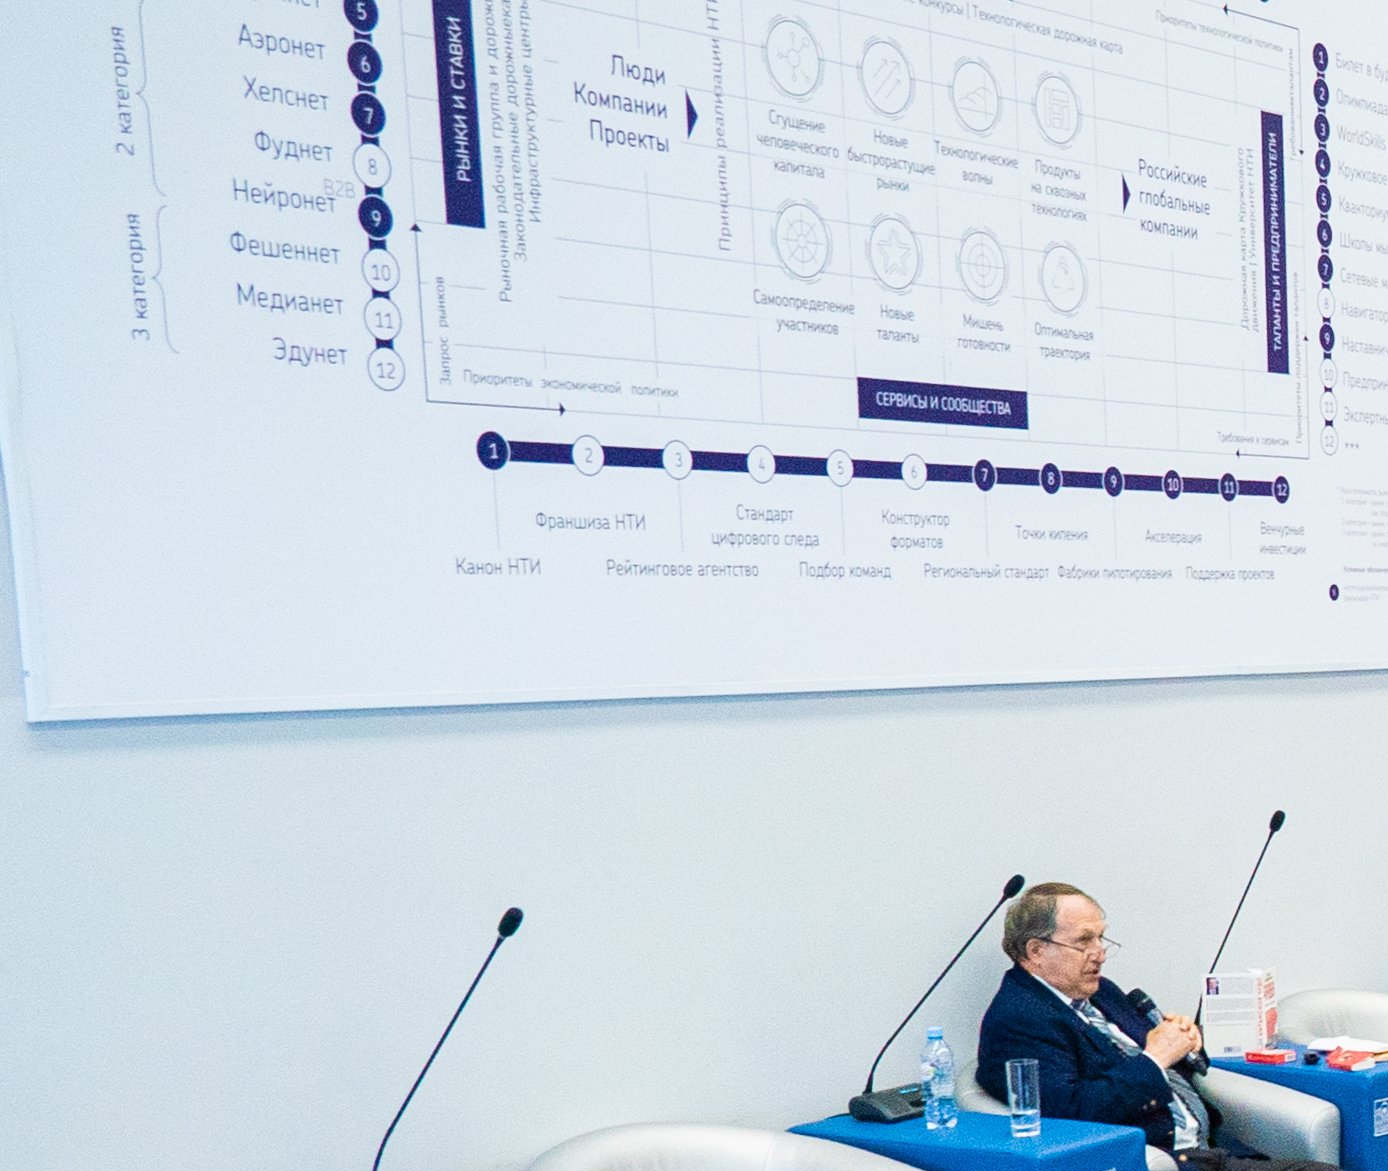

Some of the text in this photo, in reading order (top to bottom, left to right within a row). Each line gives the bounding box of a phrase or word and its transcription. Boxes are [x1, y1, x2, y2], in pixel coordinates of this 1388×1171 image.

[238, 23, 326, 60] Аэронет
[447, 16, 467, 91] СТАВКИ
[610, 53, 666, 86] Люди
[110, 27, 134, 156] 2 категория
[243, 75, 329, 111] Хелснет
[574, 81, 668, 119] Компании
[768, 109, 826, 135] Сгущение
[255, 130, 333, 163] Фуднет
[524, 62, 542, 223] Инфраструктурные
[589, 119, 670, 153] Проекты
[710, 38, 732, 252] Принципы реализации
[756, 134, 840, 159] человеческого
[872, 129, 909, 149] Новые
[456, 112, 472, 183] РЫНКИ
[934, 139, 1019, 170] Технологические
[773, 158, 826, 180] капитала
[847, 146, 936, 178] быстрорастущие
[1034, 159, 1081, 181] Продукты
[876, 176, 910, 193] рынки
[962, 169, 994, 187] волны
[1138, 158, 1208, 189] Российские
[233, 177, 337, 214] Нейронет
[489, 80, 512, 303] Рыночная рабочая группа
[507, 111, 527, 263] Законодательные
[1045, 184, 1087, 202] сквозных
[1030, 202, 1087, 222] технологиях
[1139, 189, 1211, 216] глобальные
[1268, 132, 1281, 272] ПРЕДПРИНИМАТЕЛИ
[1139, 218, 1199, 240] компании
[230, 231, 341, 265] Фешеннет
[127, 213, 150, 342] 3 категория
[371, 263, 391, 282] 10
[236, 283, 345, 316] Медианет
[752, 288, 855, 317] Самоопределение
[375, 311, 393, 330] 11
[879, 303, 915, 323] Новые
[962, 314, 1004, 333] Мишень
[1273, 288, 1283, 351] ТАЛАНТЫ
[436, 276, 453, 386] Запрос рынков
[775, 317, 839, 338] участников
[876, 327, 920, 345] таланты
[1033, 321, 1095, 342] Оптимальная
[272, 337, 348, 366] Эдунет
[957, 335, 1012, 354] готовности
[1039, 344, 1091, 362] траектория
[377, 362, 396, 380] 12
[463, 368, 679, 399] Приоритеты экономической политики
[875, 390, 1012, 418] СЕРВИСЫ И СООБЩЕСТВА
[1224, 481, 1235, 494] 11
[1276, 484, 1288, 497] 12
[536, 511, 647, 532] Франшиза НТИ
[736, 503, 793, 525] Стандарт
[880, 509, 951, 528] Конструктор
[711, 531, 820, 549] цифрового следа
[1015, 524, 1088, 542] Точки кипения
[1145, 528, 1202, 546] Акселерация
[1260, 520, 1305, 538] Венчурные
[890, 533, 944, 550] форматов
[1259, 543, 1307, 556] инвестиции
[455, 557, 542, 576] Канон НТИ
[606, 558, 759, 578] Рейтинговое агентство
[799, 561, 892, 580] Подбор команд
[923, 562, 1050, 581] Региональный стандарт
[1057, 564, 1173, 581] Фабрики пилотирования
[1185, 565, 1275, 582] Поддержка проектов
